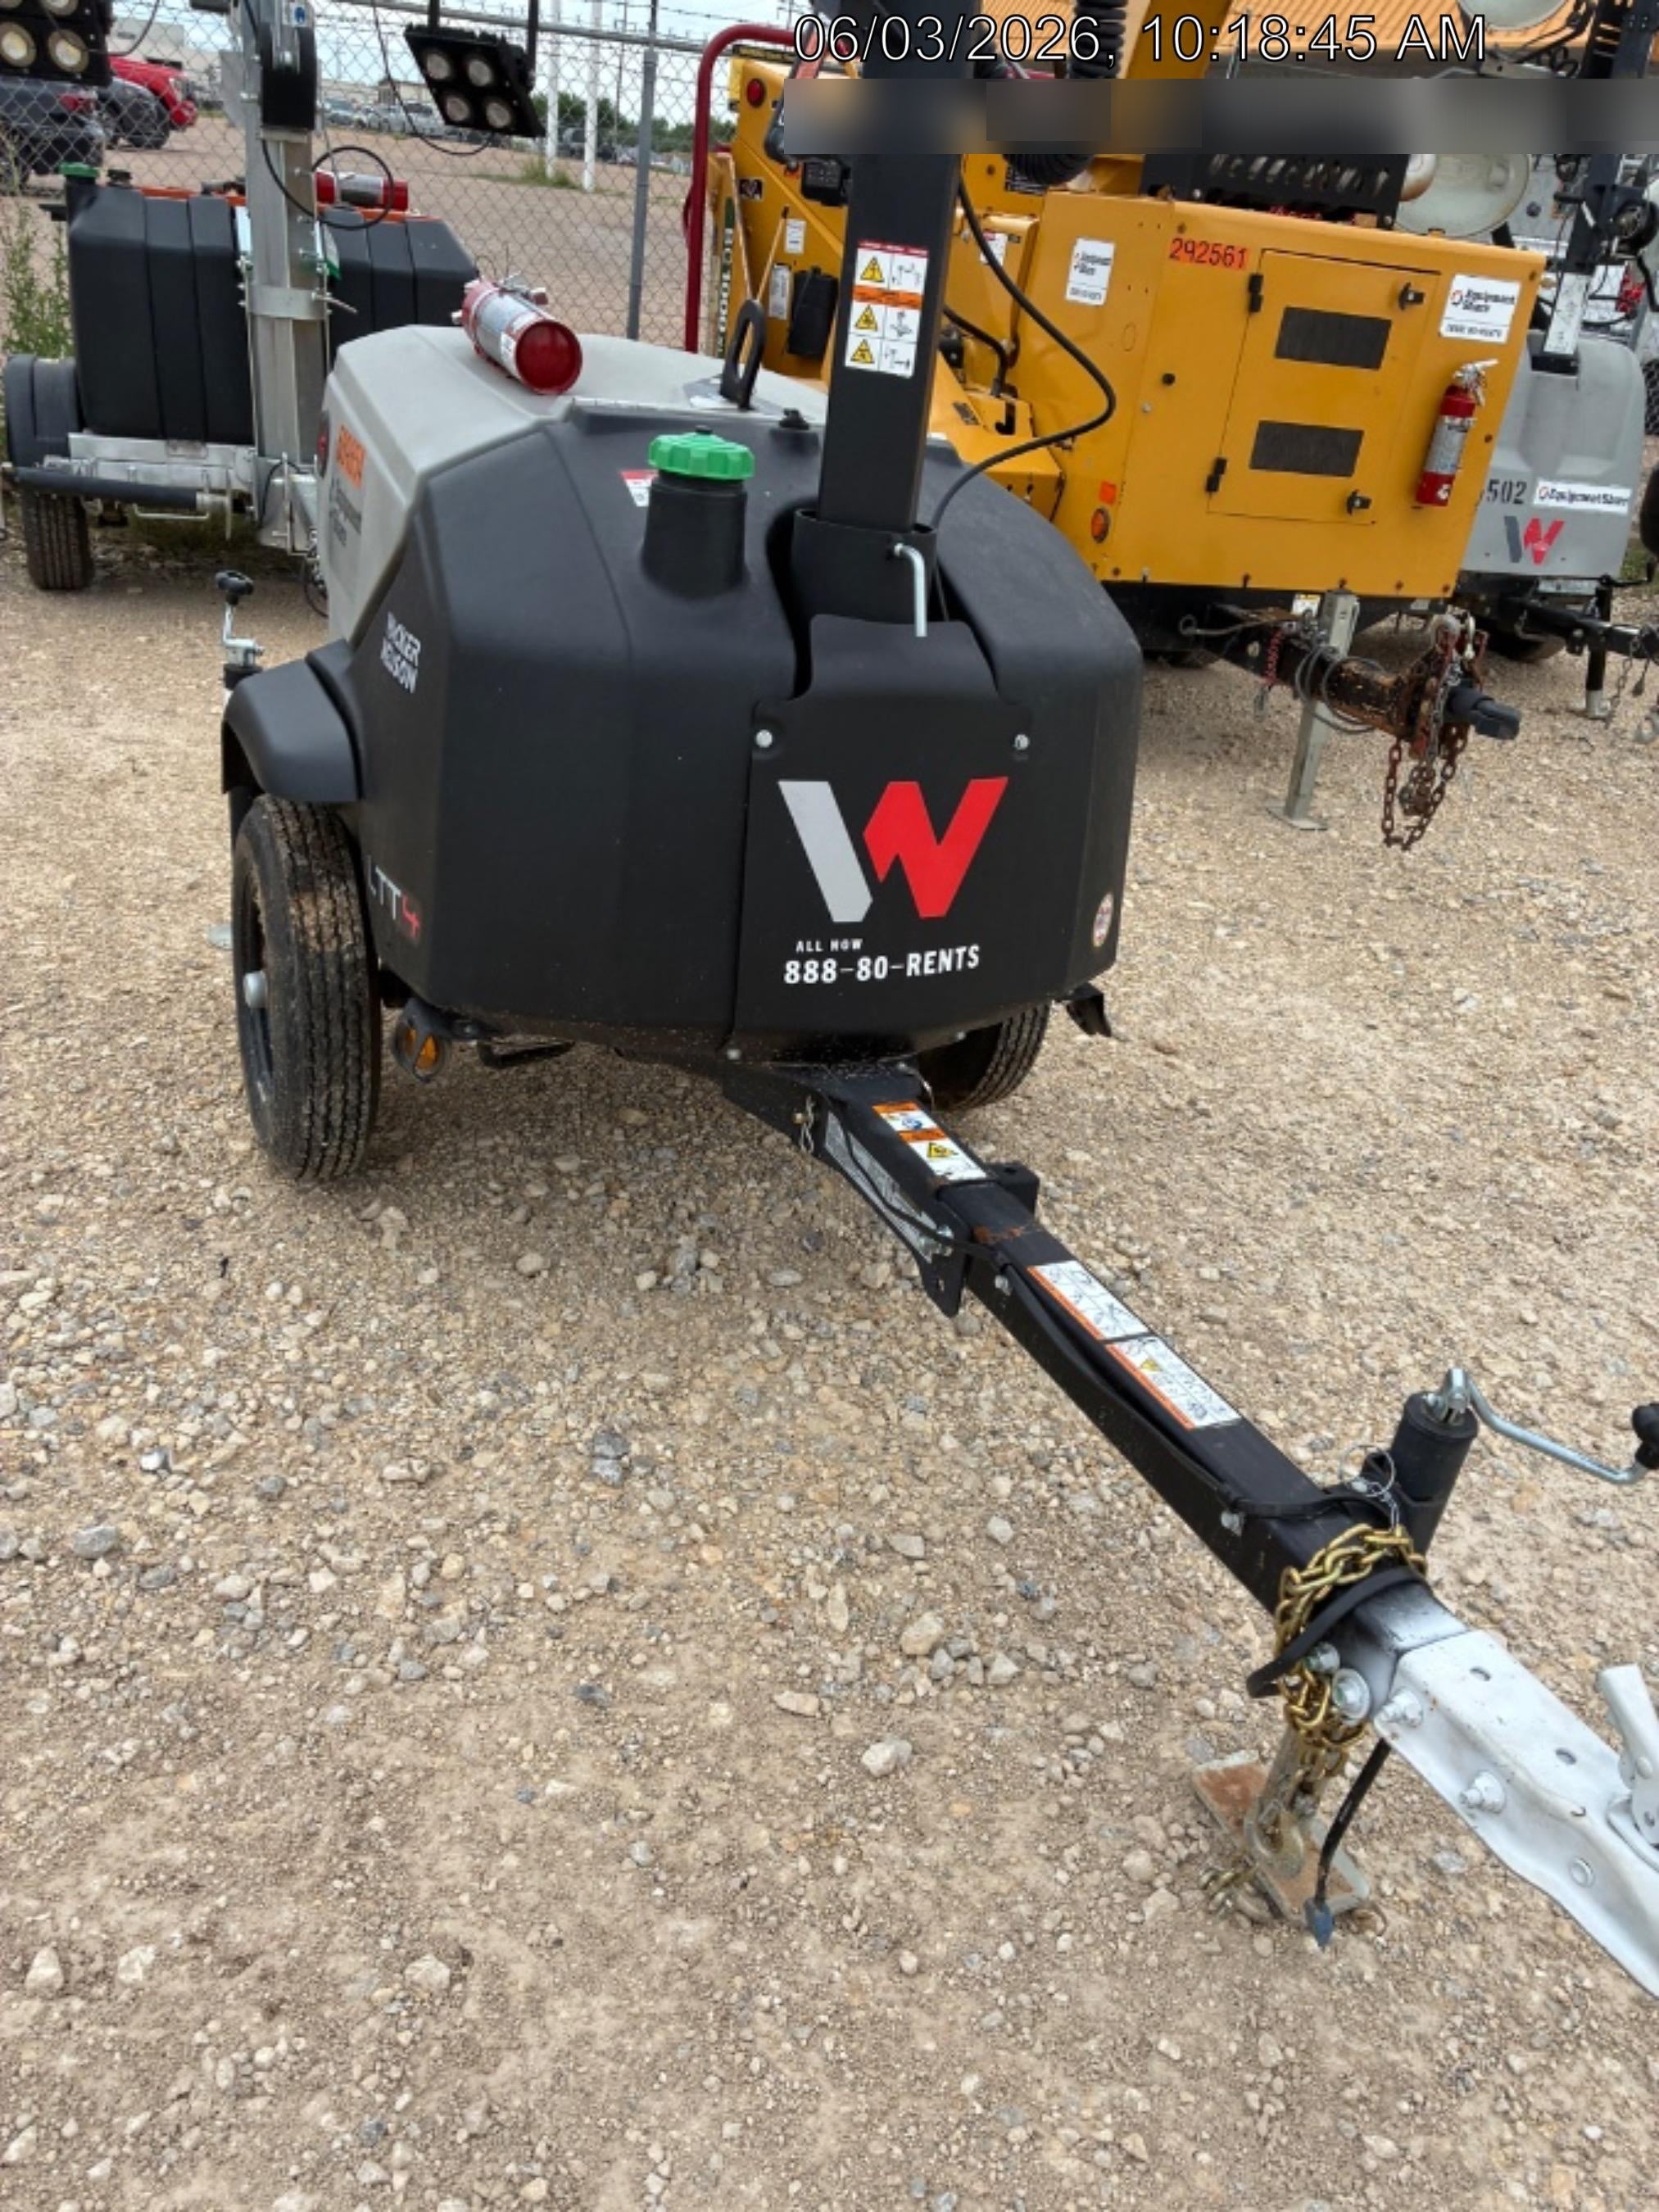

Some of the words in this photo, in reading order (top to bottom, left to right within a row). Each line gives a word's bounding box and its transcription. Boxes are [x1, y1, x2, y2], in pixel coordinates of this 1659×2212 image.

[1169, 238, 1246, 269] 292561
[796, 940, 824, 954] ALL
[830, 938, 863, 952] NOW
[784, 945, 981, 984] 888-80-RENTS
